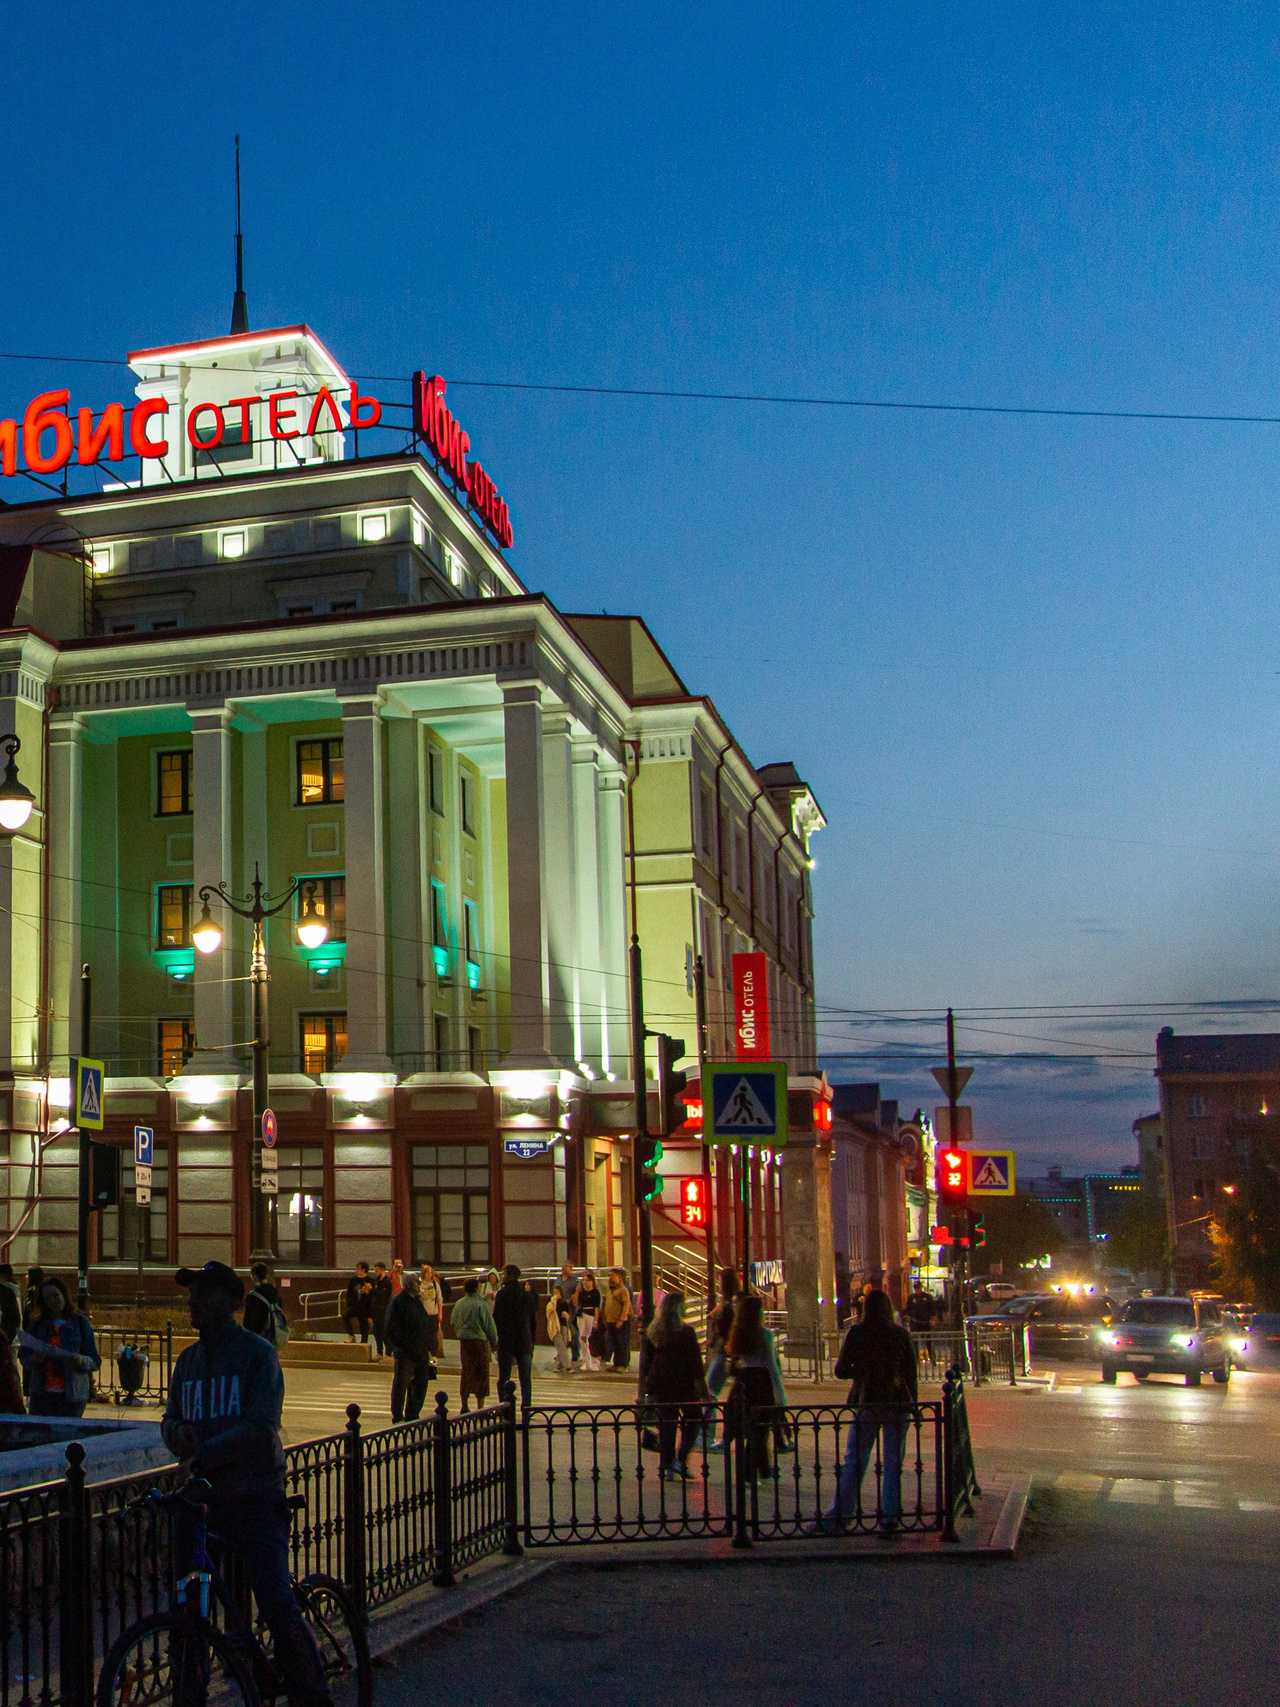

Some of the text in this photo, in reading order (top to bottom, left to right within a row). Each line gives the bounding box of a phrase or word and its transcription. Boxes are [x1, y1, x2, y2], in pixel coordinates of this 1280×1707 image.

[738, 1009, 756, 1049] ибис
[686, 1104, 703, 1118] ibi
[138, 1130, 150, 1160] P
[685, 1205, 702, 1222] 34
